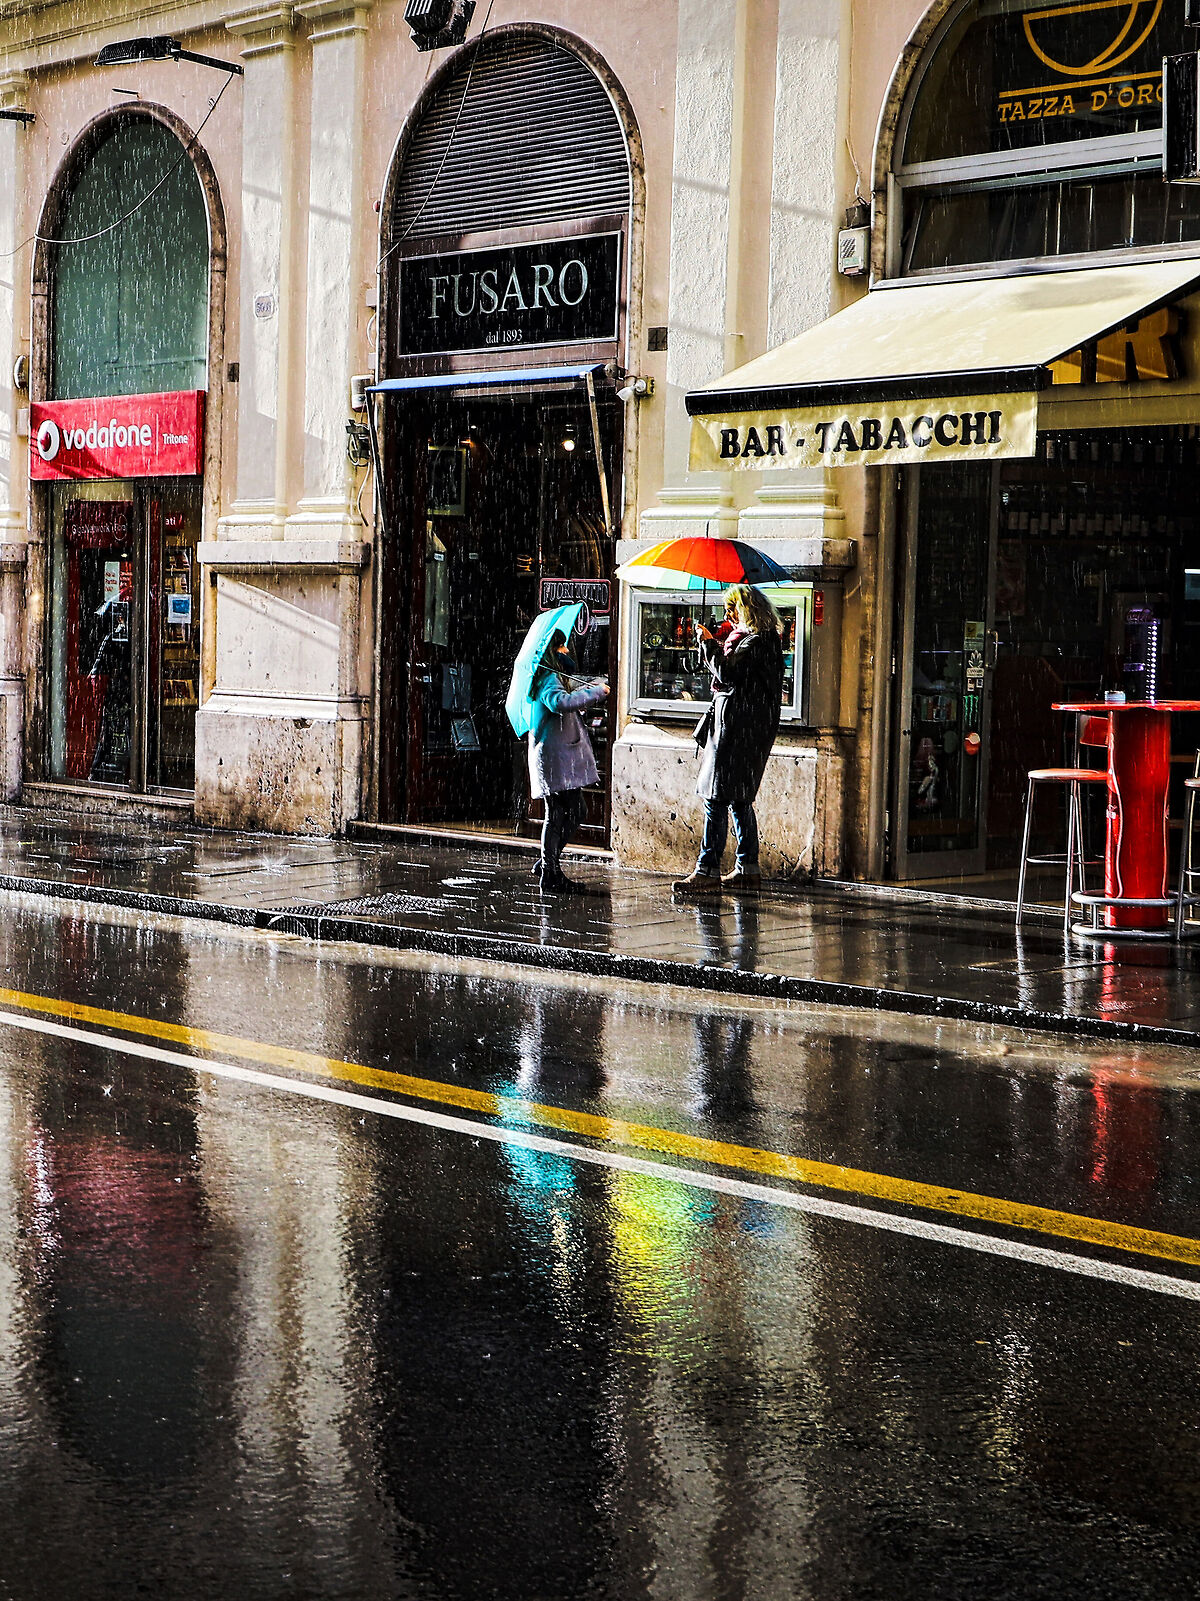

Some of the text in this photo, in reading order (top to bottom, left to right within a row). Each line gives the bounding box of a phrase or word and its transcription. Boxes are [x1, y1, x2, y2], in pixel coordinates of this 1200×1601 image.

[998, 95, 1076, 123] TAZZA
[427, 259, 589, 319] FUSARO
[485, 329, 523, 344] dal 1893
[62, 418, 189, 450] vodafone Tritone
[720, 425, 788, 459] BAR
[814, 410, 1003, 453] TABACCHI
[542, 582, 608, 605] FUORI TUTTO
